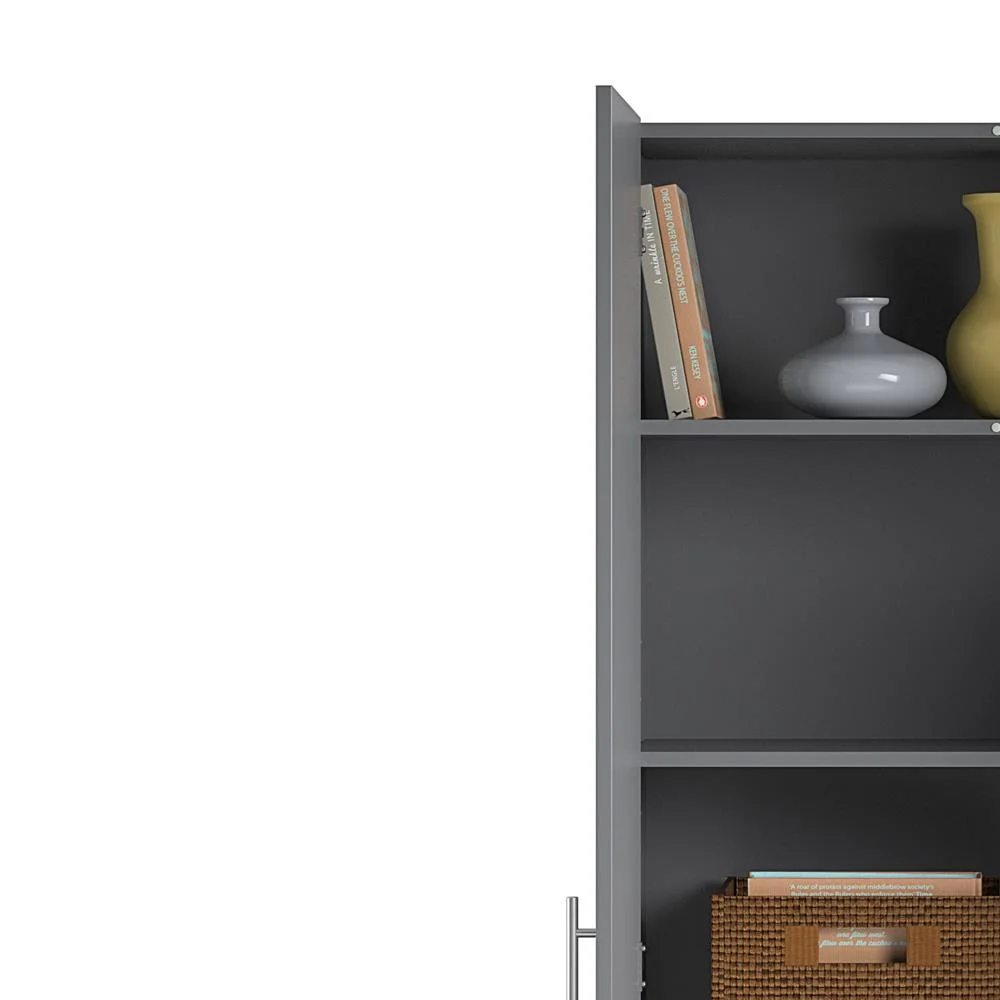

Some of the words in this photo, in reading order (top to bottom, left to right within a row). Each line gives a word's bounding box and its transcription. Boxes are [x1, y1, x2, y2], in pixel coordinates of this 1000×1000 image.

[660, 188, 671, 203] ONE
[664, 203, 674, 221] FLEW
[646, 232, 655, 242] IN
[667, 221, 677, 240] OVER
[670, 239, 679, 254] THE
[649, 243, 661, 276] wrinkle
[678, 287, 688, 304] NEST
[688, 345, 698, 359] KEN
[691, 359, 701, 380] KESEY
